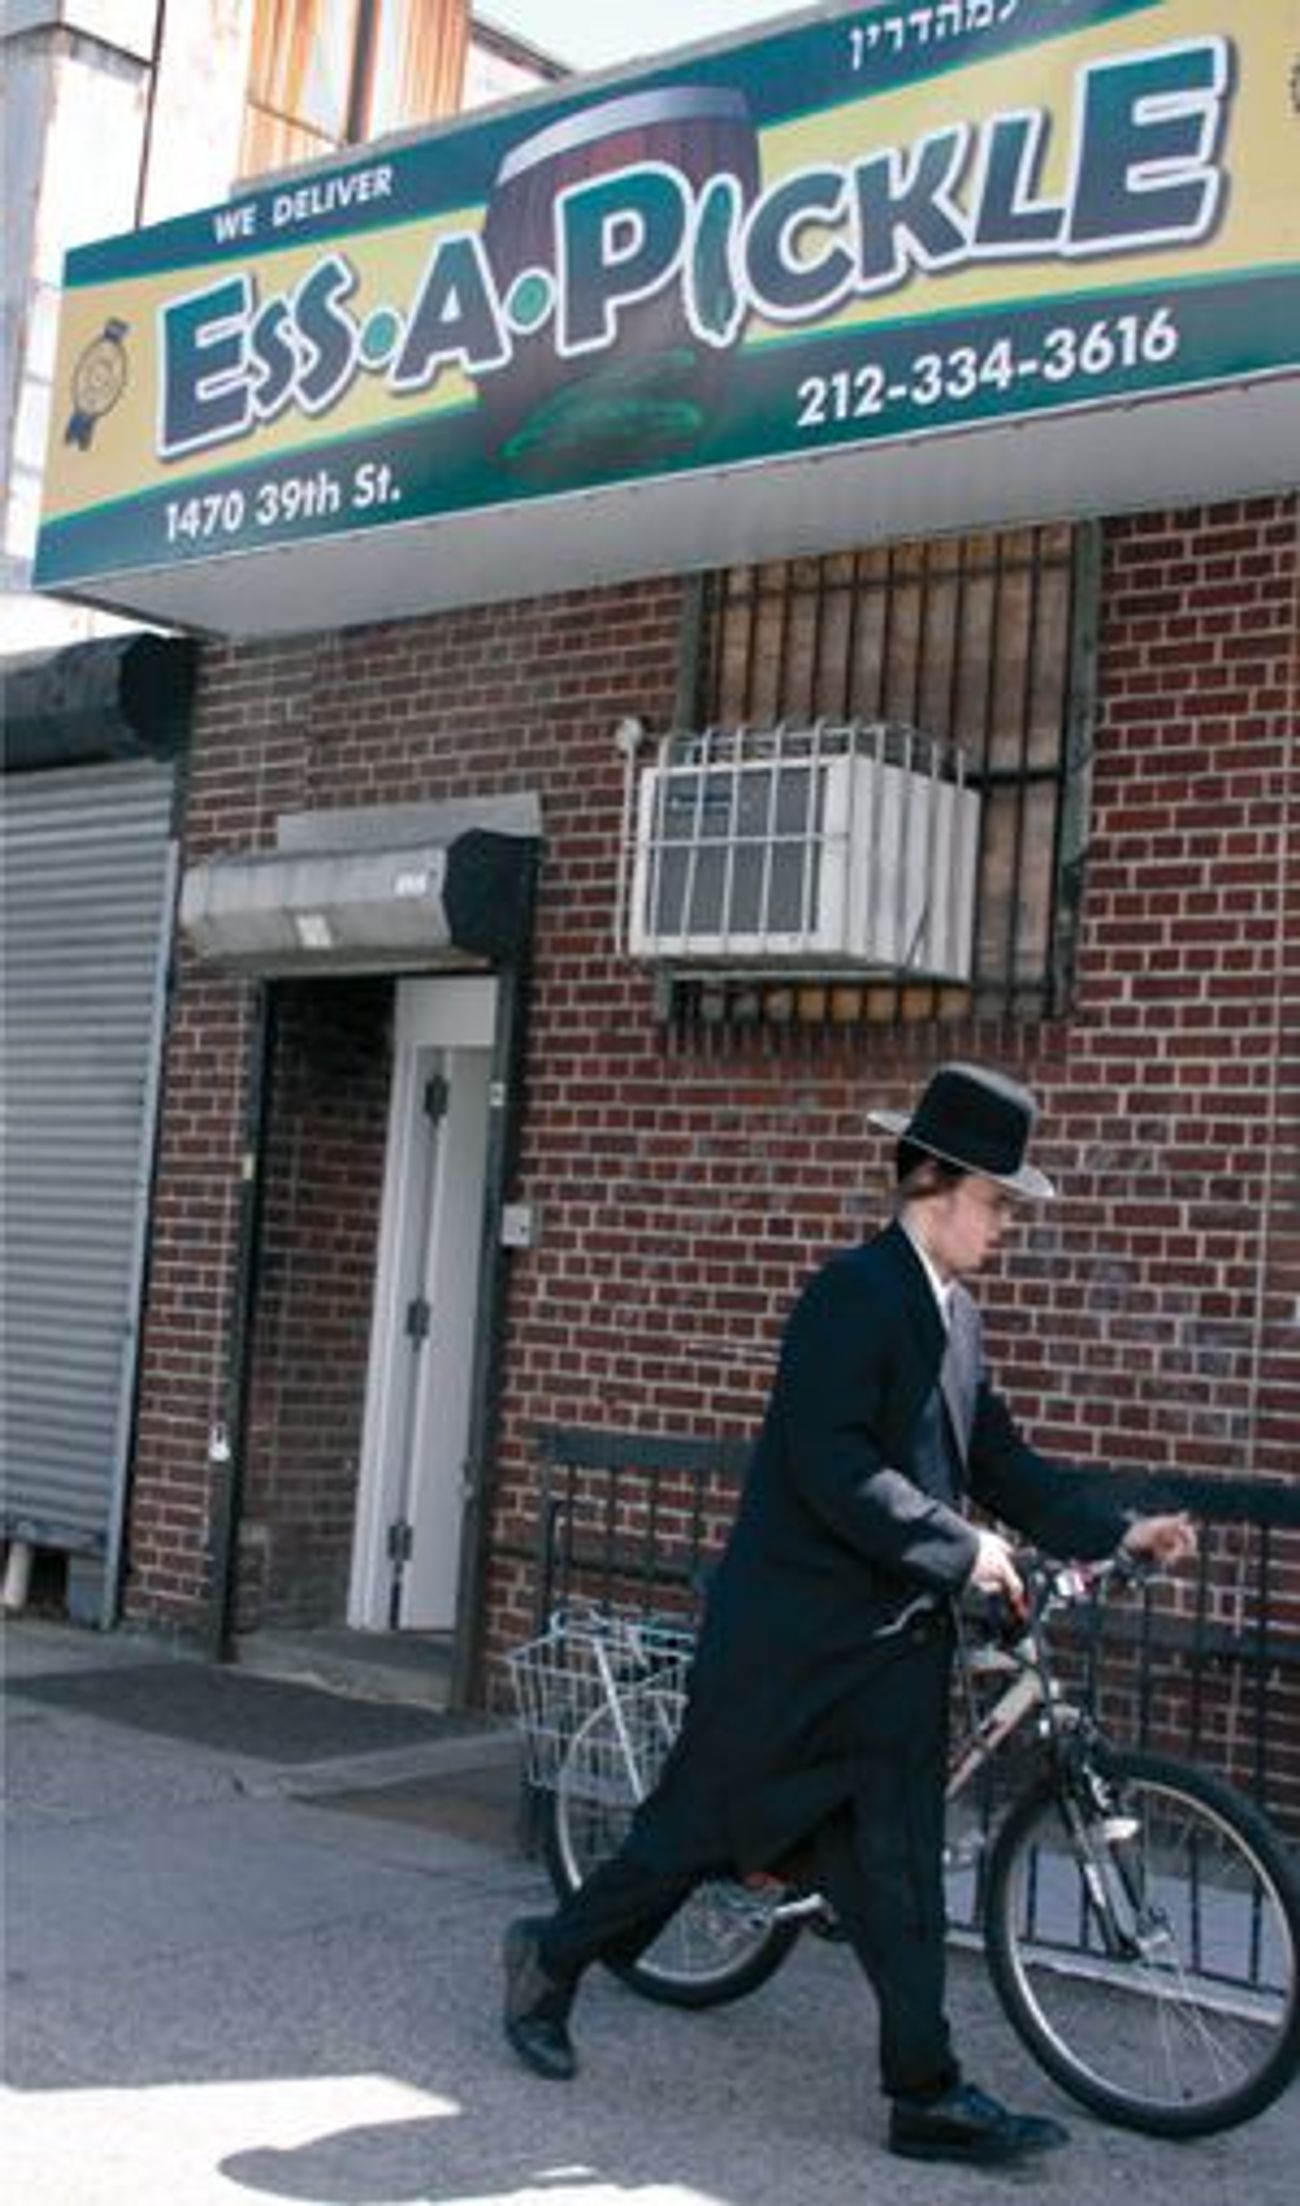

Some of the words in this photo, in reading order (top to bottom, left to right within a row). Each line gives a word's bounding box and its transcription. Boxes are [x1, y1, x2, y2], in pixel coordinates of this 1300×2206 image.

[214, 204, 258, 245] WE
[272, 165, 394, 227] DELIVER
[797, 307, 1179, 427] 212-334-3616
[166, 489, 245, 543] 1470
[255, 470, 341, 526] 39th
[352, 461, 402, 508] St.
